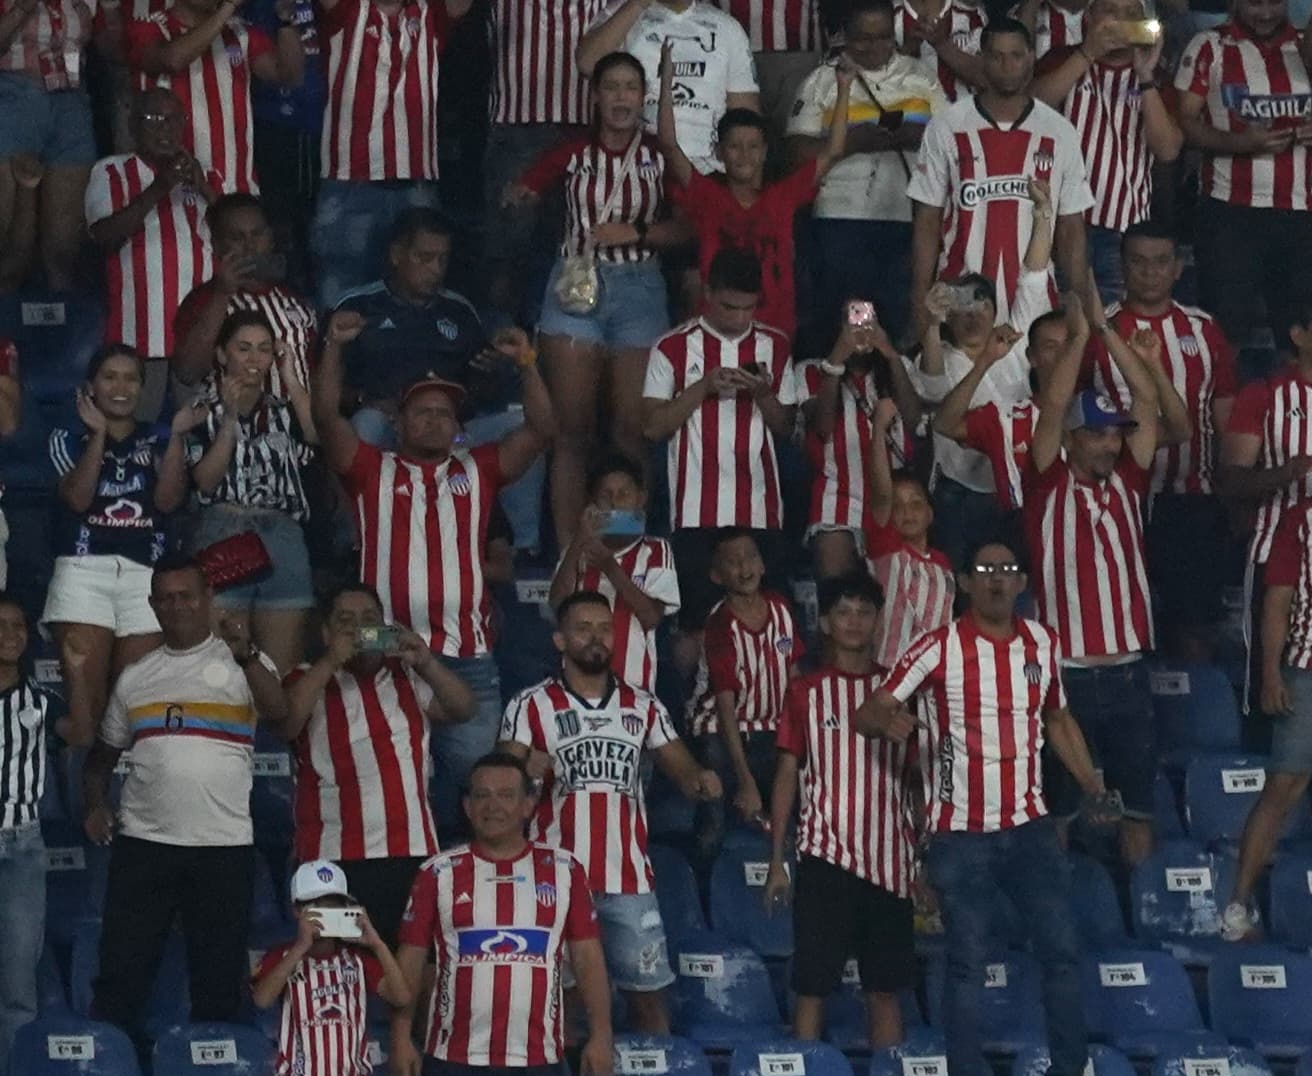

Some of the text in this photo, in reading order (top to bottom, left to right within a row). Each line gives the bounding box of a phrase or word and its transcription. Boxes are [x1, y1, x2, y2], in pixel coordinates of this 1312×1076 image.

[1240, 96, 1312, 121] AGUILA
[554, 710, 582, 740] 10
[564, 740, 635, 766] CERVEZA
[568, 760, 630, 786] AGUILA
[461, 951, 548, 967] OLIMPICA
